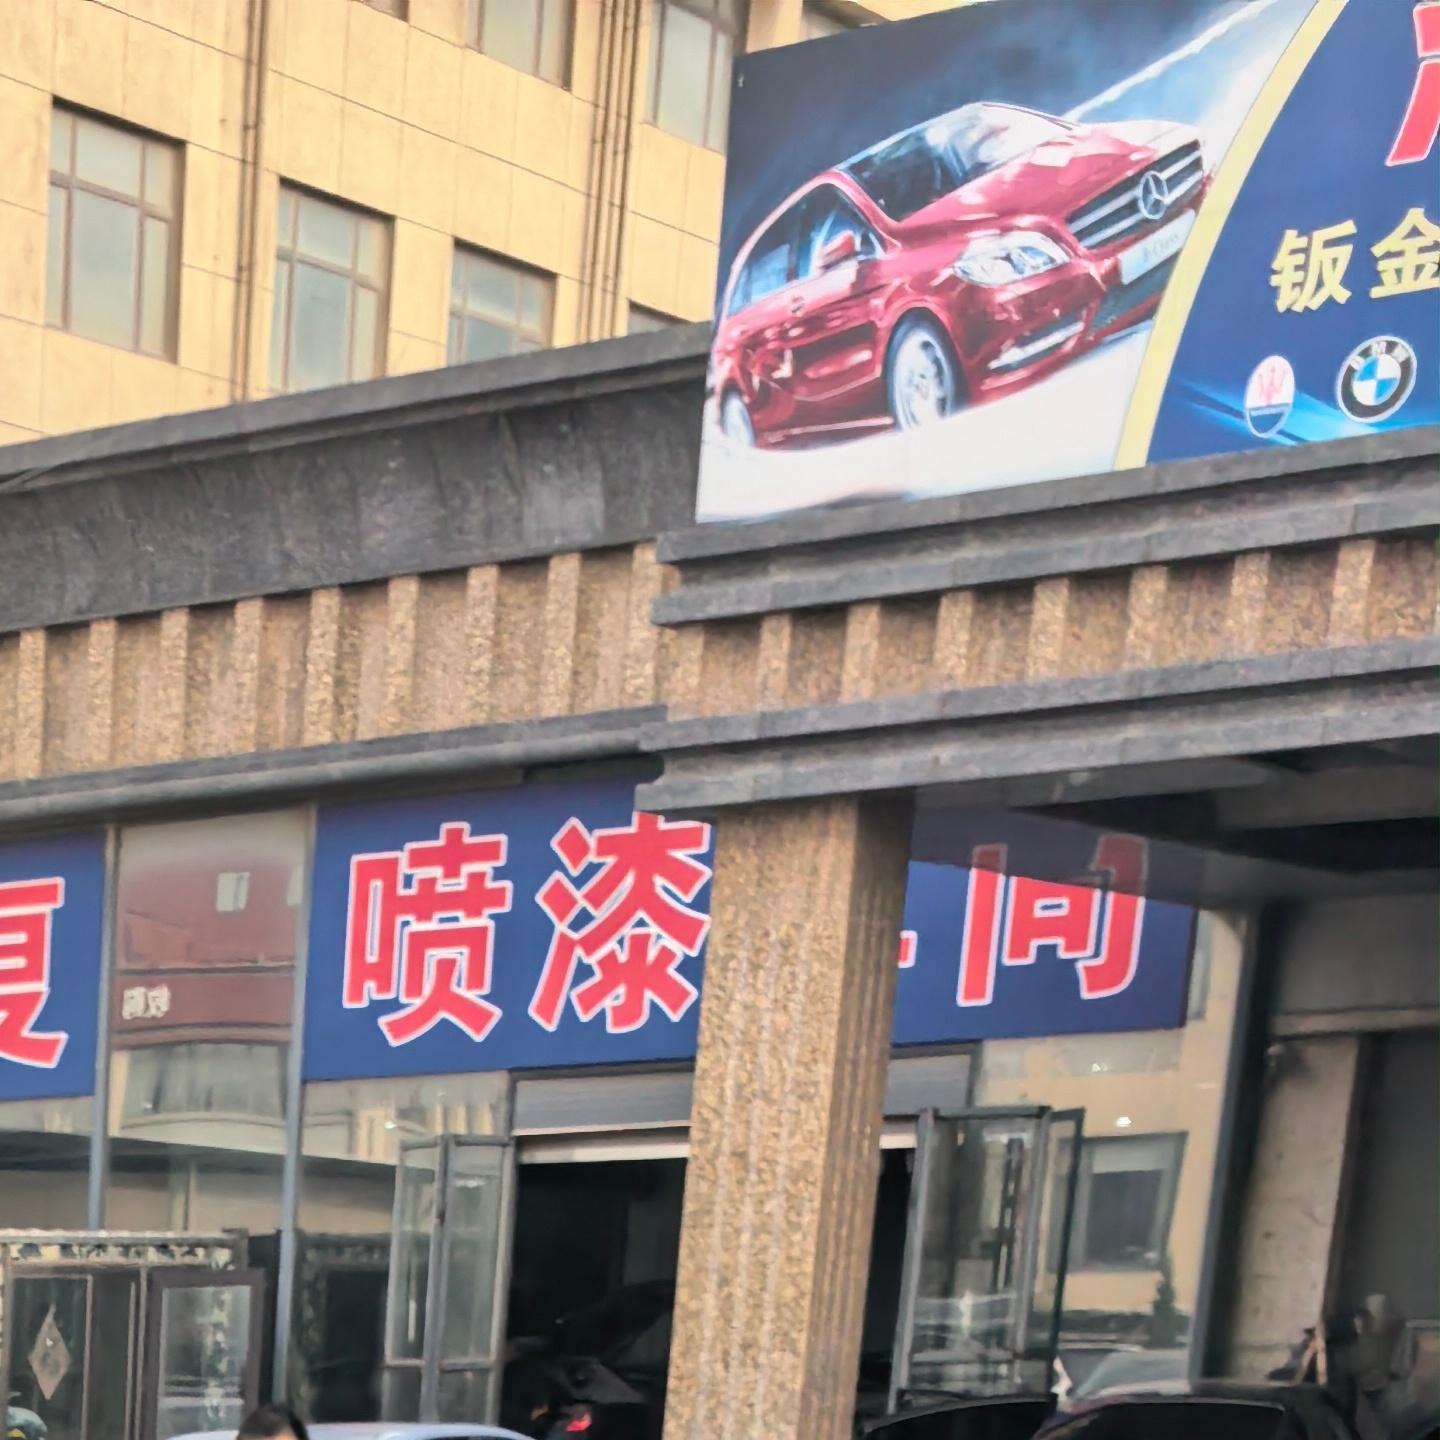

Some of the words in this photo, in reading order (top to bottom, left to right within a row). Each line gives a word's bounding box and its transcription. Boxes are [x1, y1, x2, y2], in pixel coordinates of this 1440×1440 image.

[1270, 207, 1440, 314] 钣金
[341, 810, 1149, 1047] 喷漆间
